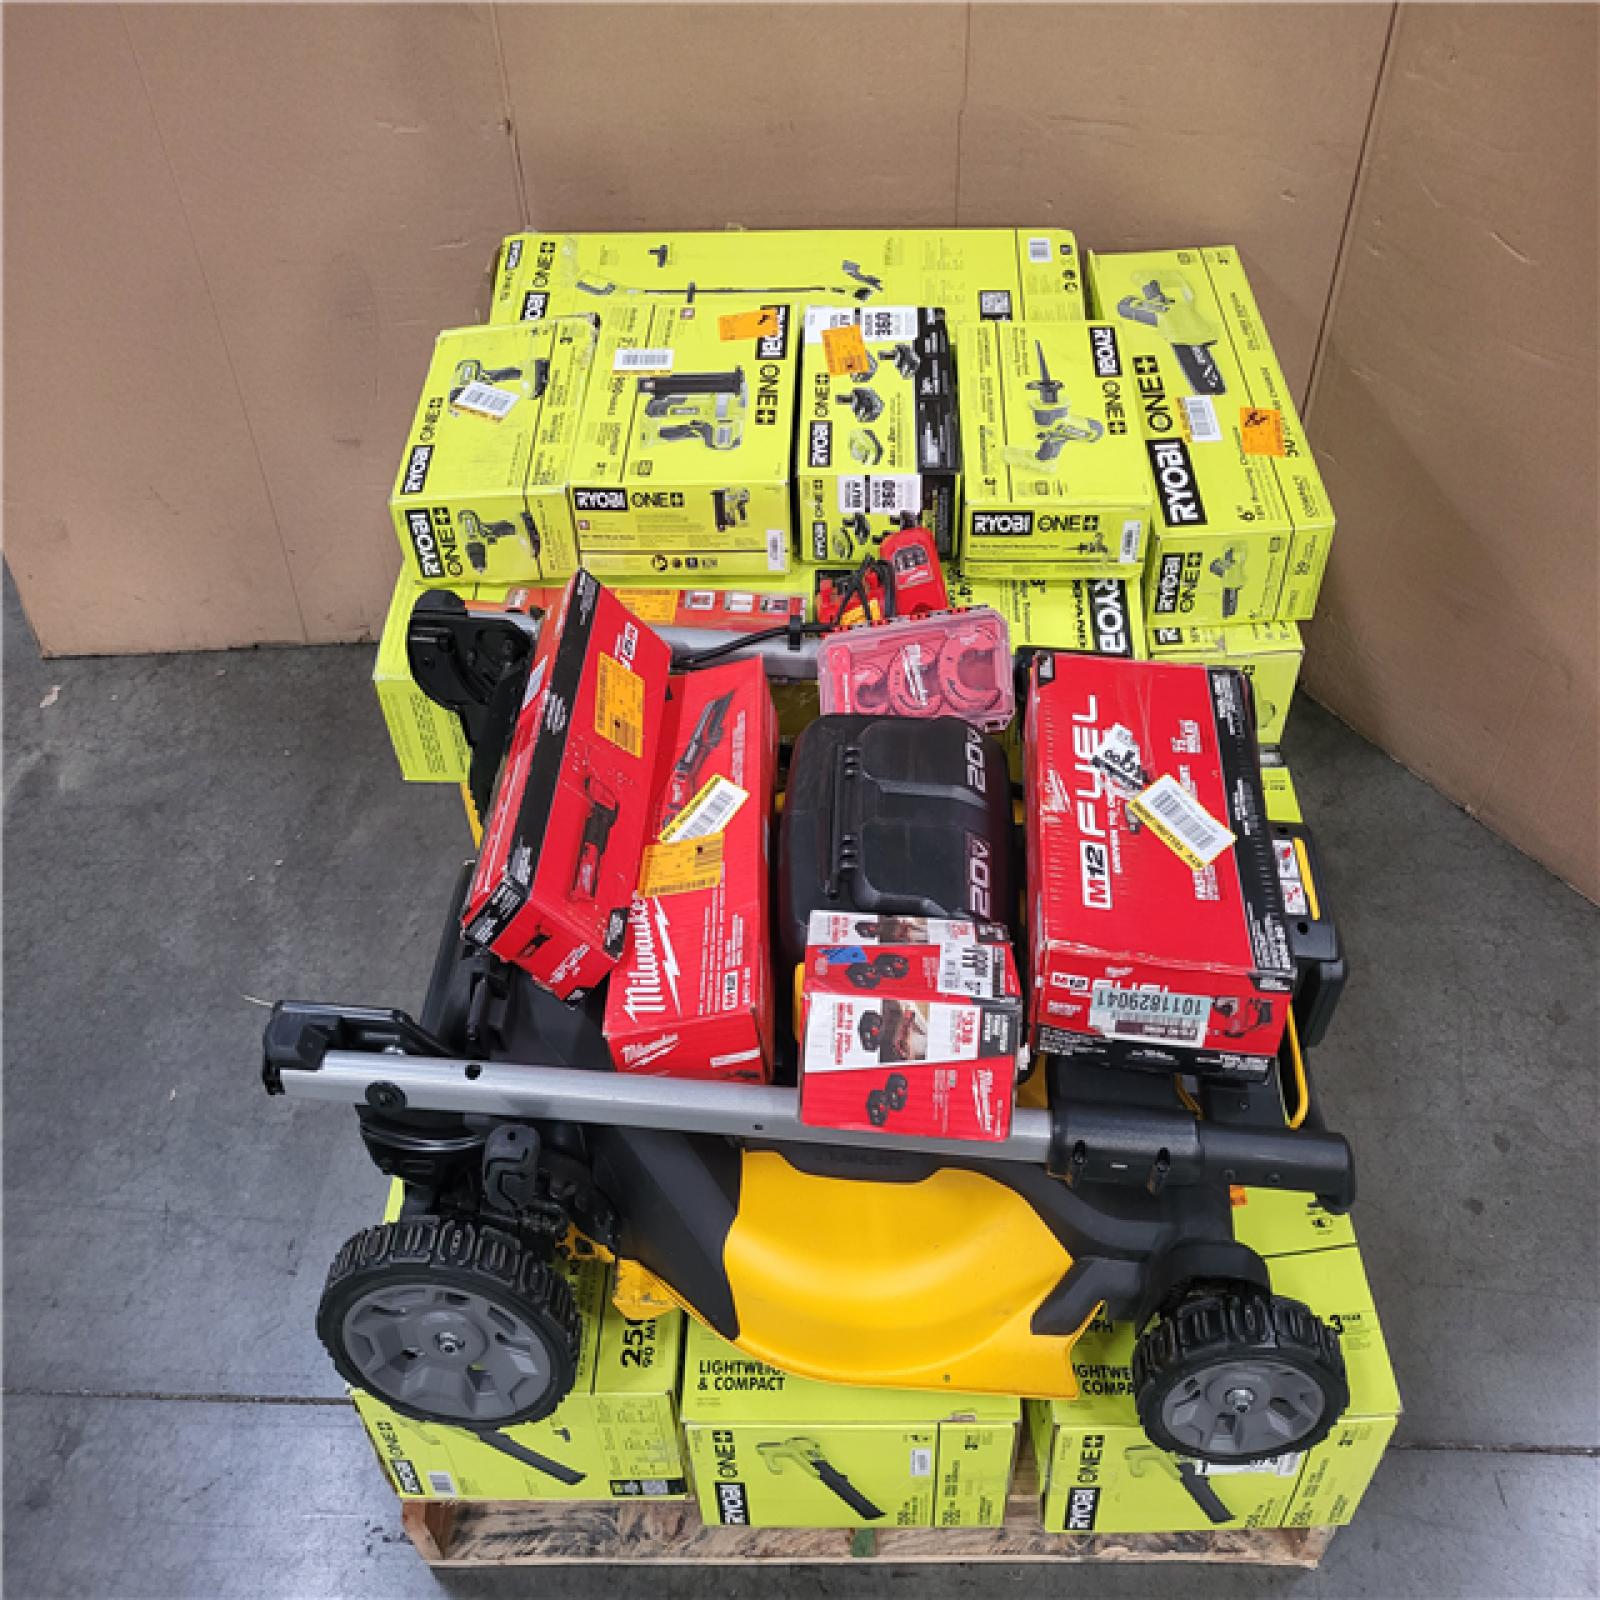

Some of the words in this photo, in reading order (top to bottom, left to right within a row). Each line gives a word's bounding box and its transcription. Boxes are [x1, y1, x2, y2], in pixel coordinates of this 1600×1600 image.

[1091, 328, 1120, 376] RYOBI
[810, 421, 831, 467] RYOBI
[402, 446, 433, 493] RYOBI
[1152, 440, 1202, 525] RYOBI
[575, 490, 627, 510] RYOBI
[972, 513, 1034, 534] RYOBI
[408, 511, 443, 577] RYOBI
[1157, 555, 1183, 611] RYOBI
[1094, 580, 1126, 651] RYOB
[1072, 695, 1106, 836] FUEL
[1083, 844, 1110, 907] M12
[624, 890, 667, 1023] Milwauke
[1329, 1315, 1343, 1333] 3
[714, 1377, 785, 1391] COMPACT
[718, 1483, 748, 1524] RYOBI
[1068, 1487, 1096, 1529] RYOBI
